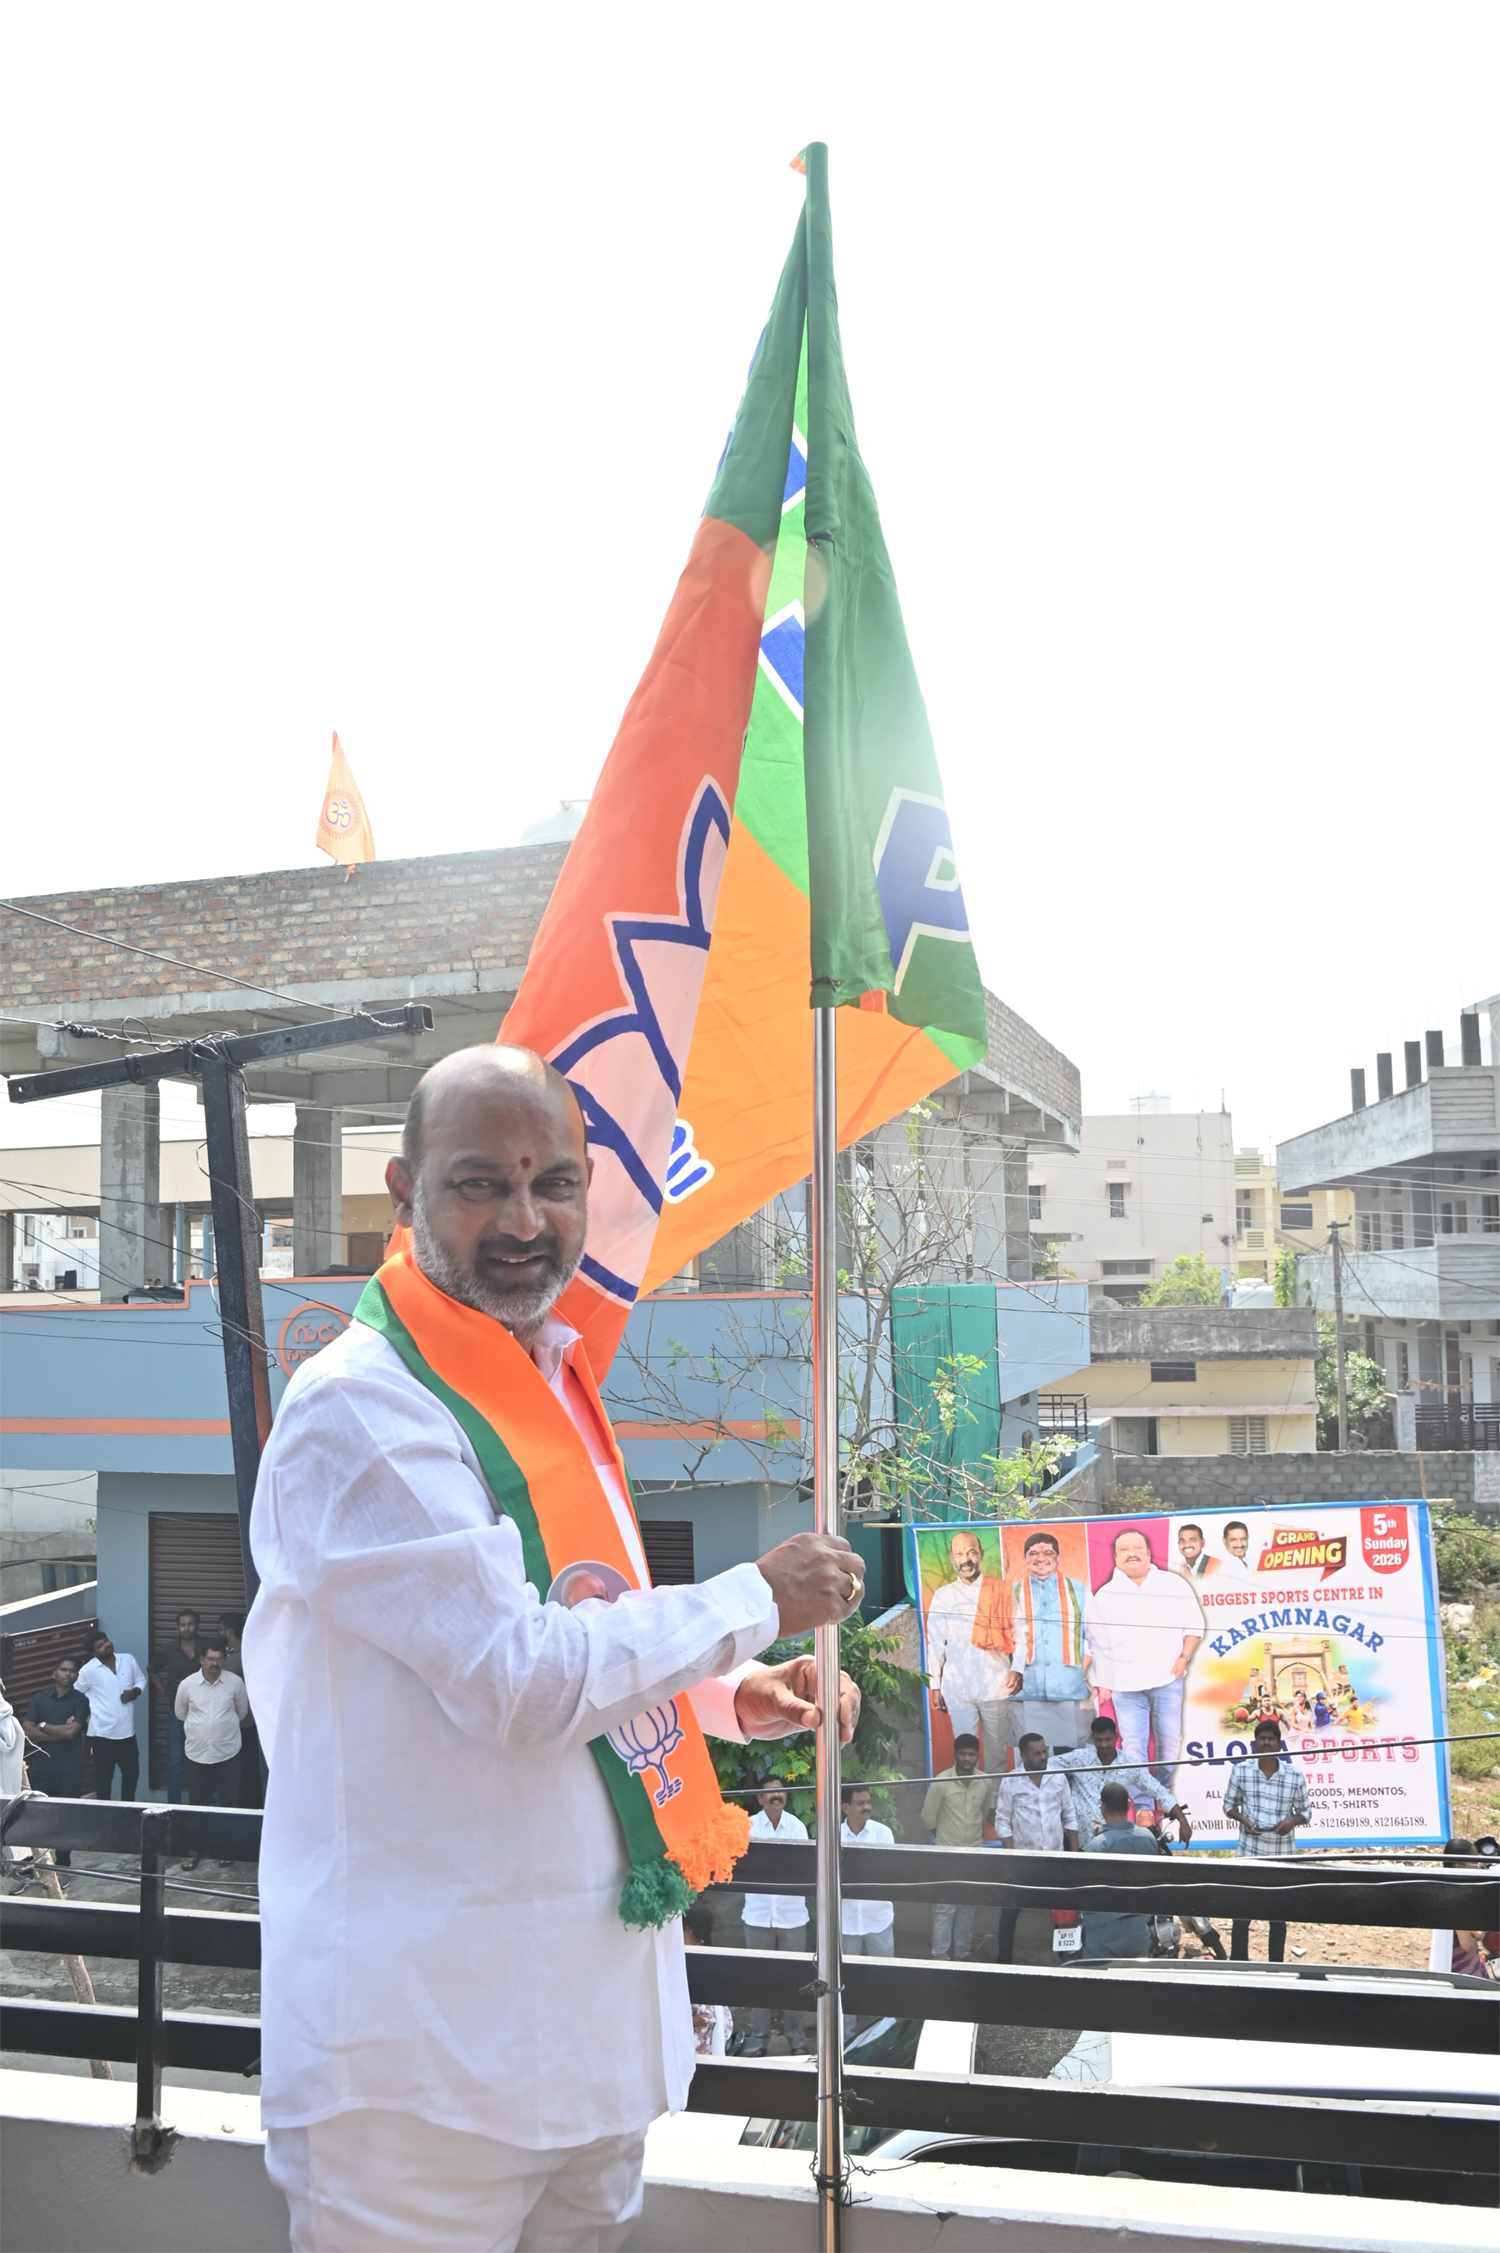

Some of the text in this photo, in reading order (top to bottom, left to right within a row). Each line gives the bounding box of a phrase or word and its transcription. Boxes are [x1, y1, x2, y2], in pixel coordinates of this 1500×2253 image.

[1373, 1513, 1397, 1536] 5th
[1276, 1532, 1316, 1546] GRAND
[1364, 1537, 1408, 1551] Sunday
[1263, 1542, 1343, 1569] OPENING
[1372, 1553, 1403, 1567] 2026
[1202, 1586, 1383, 1607] BIGGEST SPORTS CENTRE IN
[1209, 1608, 1384, 1657] KARIMNAGAR
[1301, 1735, 1420, 1764] SPORTS
[1305, 1773, 1335, 1784] TRE
[1205, 1786, 1407, 1799] ALL GOODS, MEMONTOS,
[1310, 1799, 1379, 1810] ALS, T-SHIRTS
[1191, 1819, 1224, 1830] GANDHI
[1319, 1817, 1373, 1828] 8121649189,
[1374, 1816, 1427, 1828] 8121645189.
